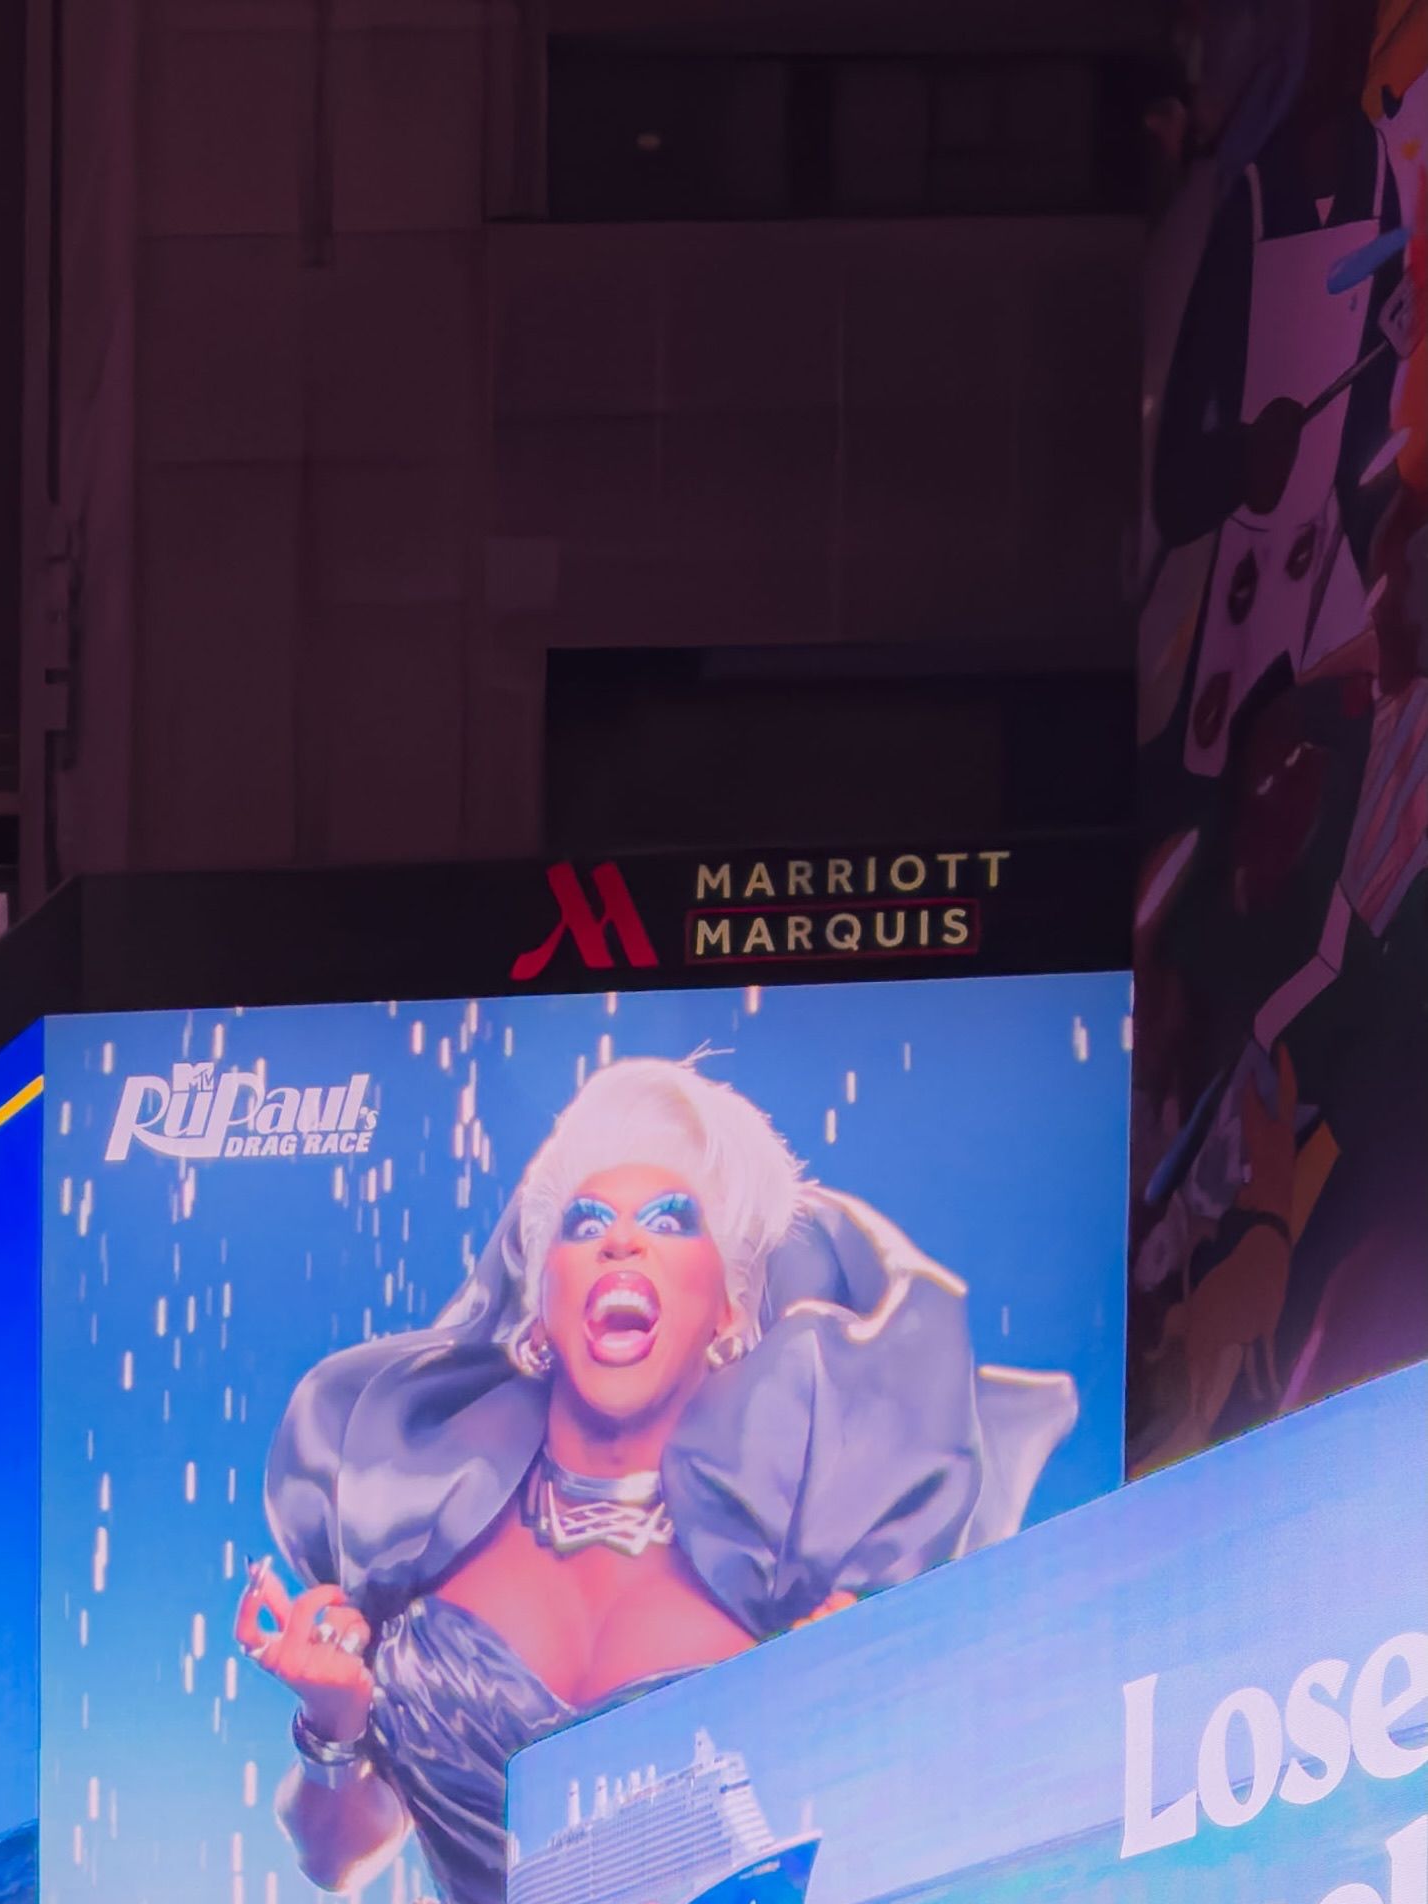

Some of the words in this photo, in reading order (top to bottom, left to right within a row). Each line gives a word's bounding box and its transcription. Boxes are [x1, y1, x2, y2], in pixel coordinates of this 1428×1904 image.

[696, 851, 1011, 900] MARRIOTT
[695, 908, 969, 955] MARQUIS
[105, 1072, 378, 1161] RuPaul's
[224, 1135, 296, 1158] DRAG
[302, 1130, 374, 1155] RACE
[1120, 1630, 1428, 1859] Lose
